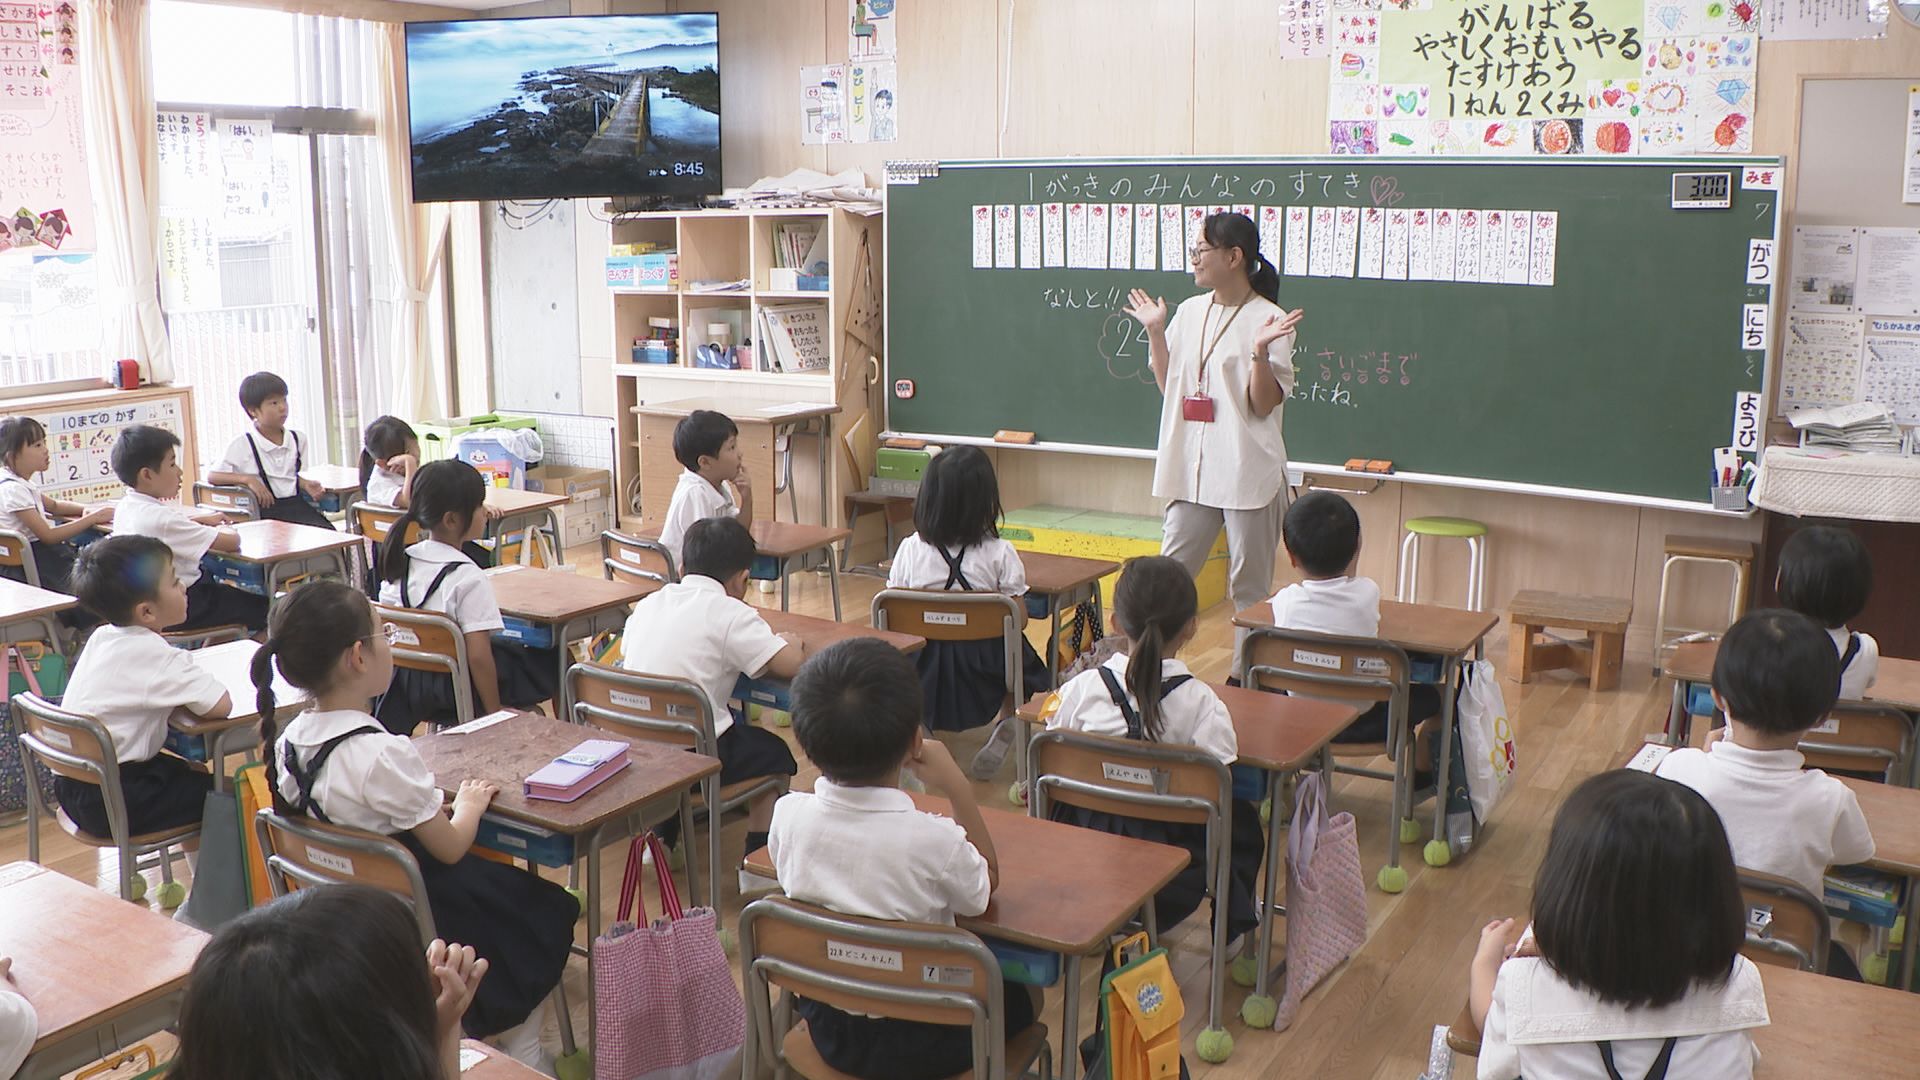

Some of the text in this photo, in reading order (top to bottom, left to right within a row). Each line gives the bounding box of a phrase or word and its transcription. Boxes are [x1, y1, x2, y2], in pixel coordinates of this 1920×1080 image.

[1458, 0, 1594, 35] がんばる
[1447, 56, 1576, 89] たすけあう
[674, 162, 704, 176] 8:45
[1746, 171, 1775, 185] みぎ
[1750, 243, 1772, 280] がつ
[1745, 309, 1764, 346] にち
[116, 409, 136, 422] かず
[1739, 394, 1757, 447] ようび
[68, 465, 79, 481] 2
[100, 460, 109, 475] 3
[1360, 660, 1367, 668] 7
[1755, 912, 1765, 922] 7
[927, 966, 935, 977] 7
